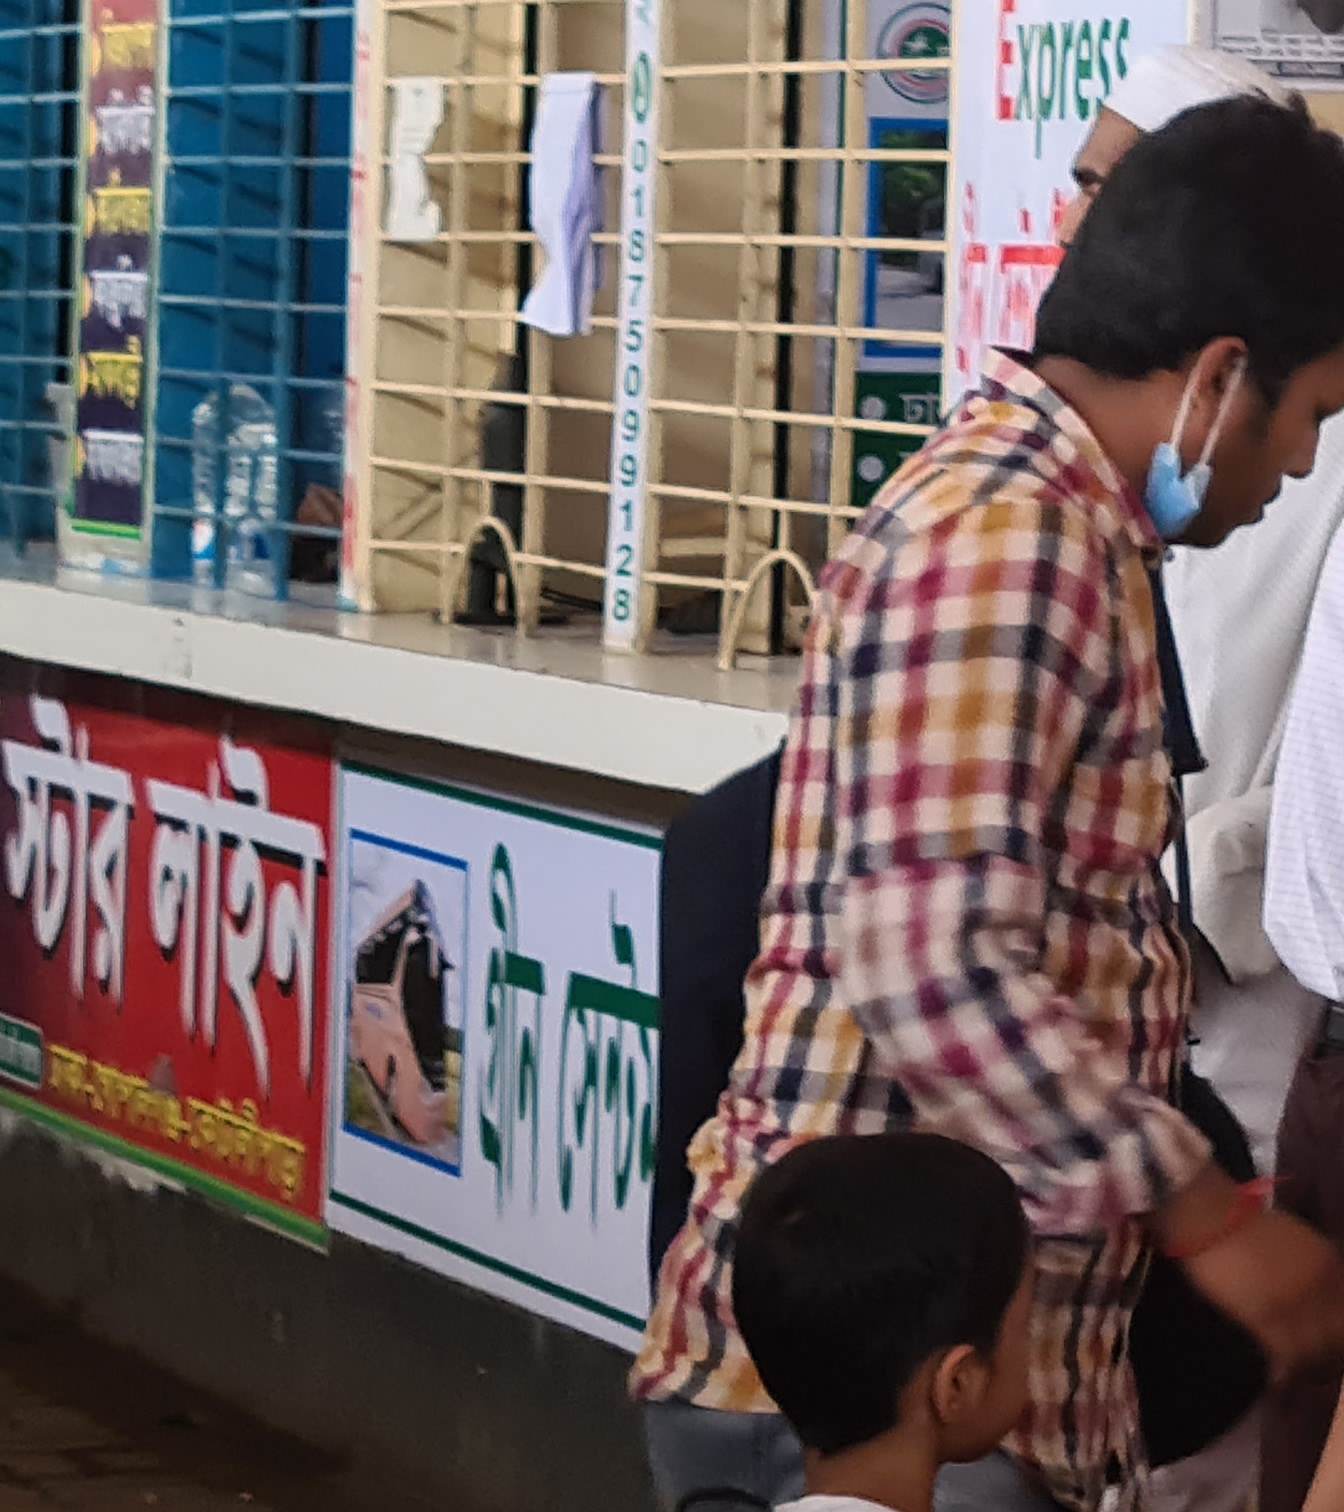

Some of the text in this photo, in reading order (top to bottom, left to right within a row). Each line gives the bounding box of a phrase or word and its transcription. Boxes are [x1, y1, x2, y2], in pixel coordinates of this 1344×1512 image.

[1, 694, 327, 1099] স্টার লাইন
[478, 842, 661, 1229] গ্রীন সেন্ট
